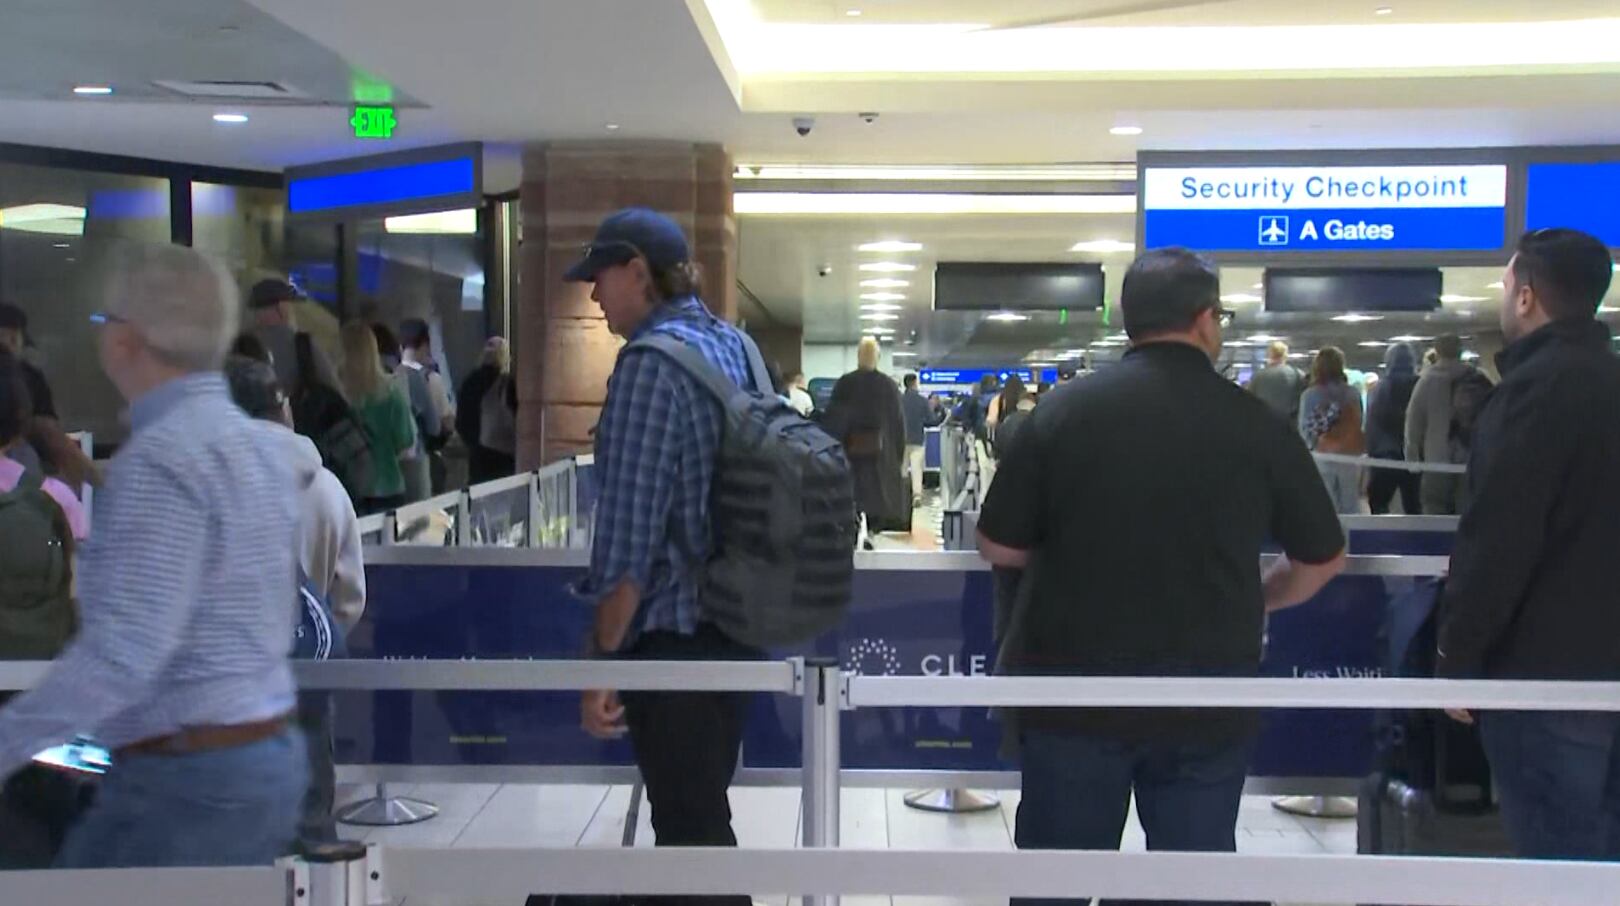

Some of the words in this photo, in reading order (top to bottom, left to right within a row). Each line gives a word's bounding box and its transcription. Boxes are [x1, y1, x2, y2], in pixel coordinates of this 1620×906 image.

[355, 107, 392, 137] EXIT
[1181, 177, 1294, 203] Security
[1305, 175, 1469, 201] Checkpoint
[1299, 220, 1319, 240] A
[1323, 219, 1395, 240] Gates
[920, 654, 987, 677] CLE
[1336, 667, 1382, 678] Waiti
